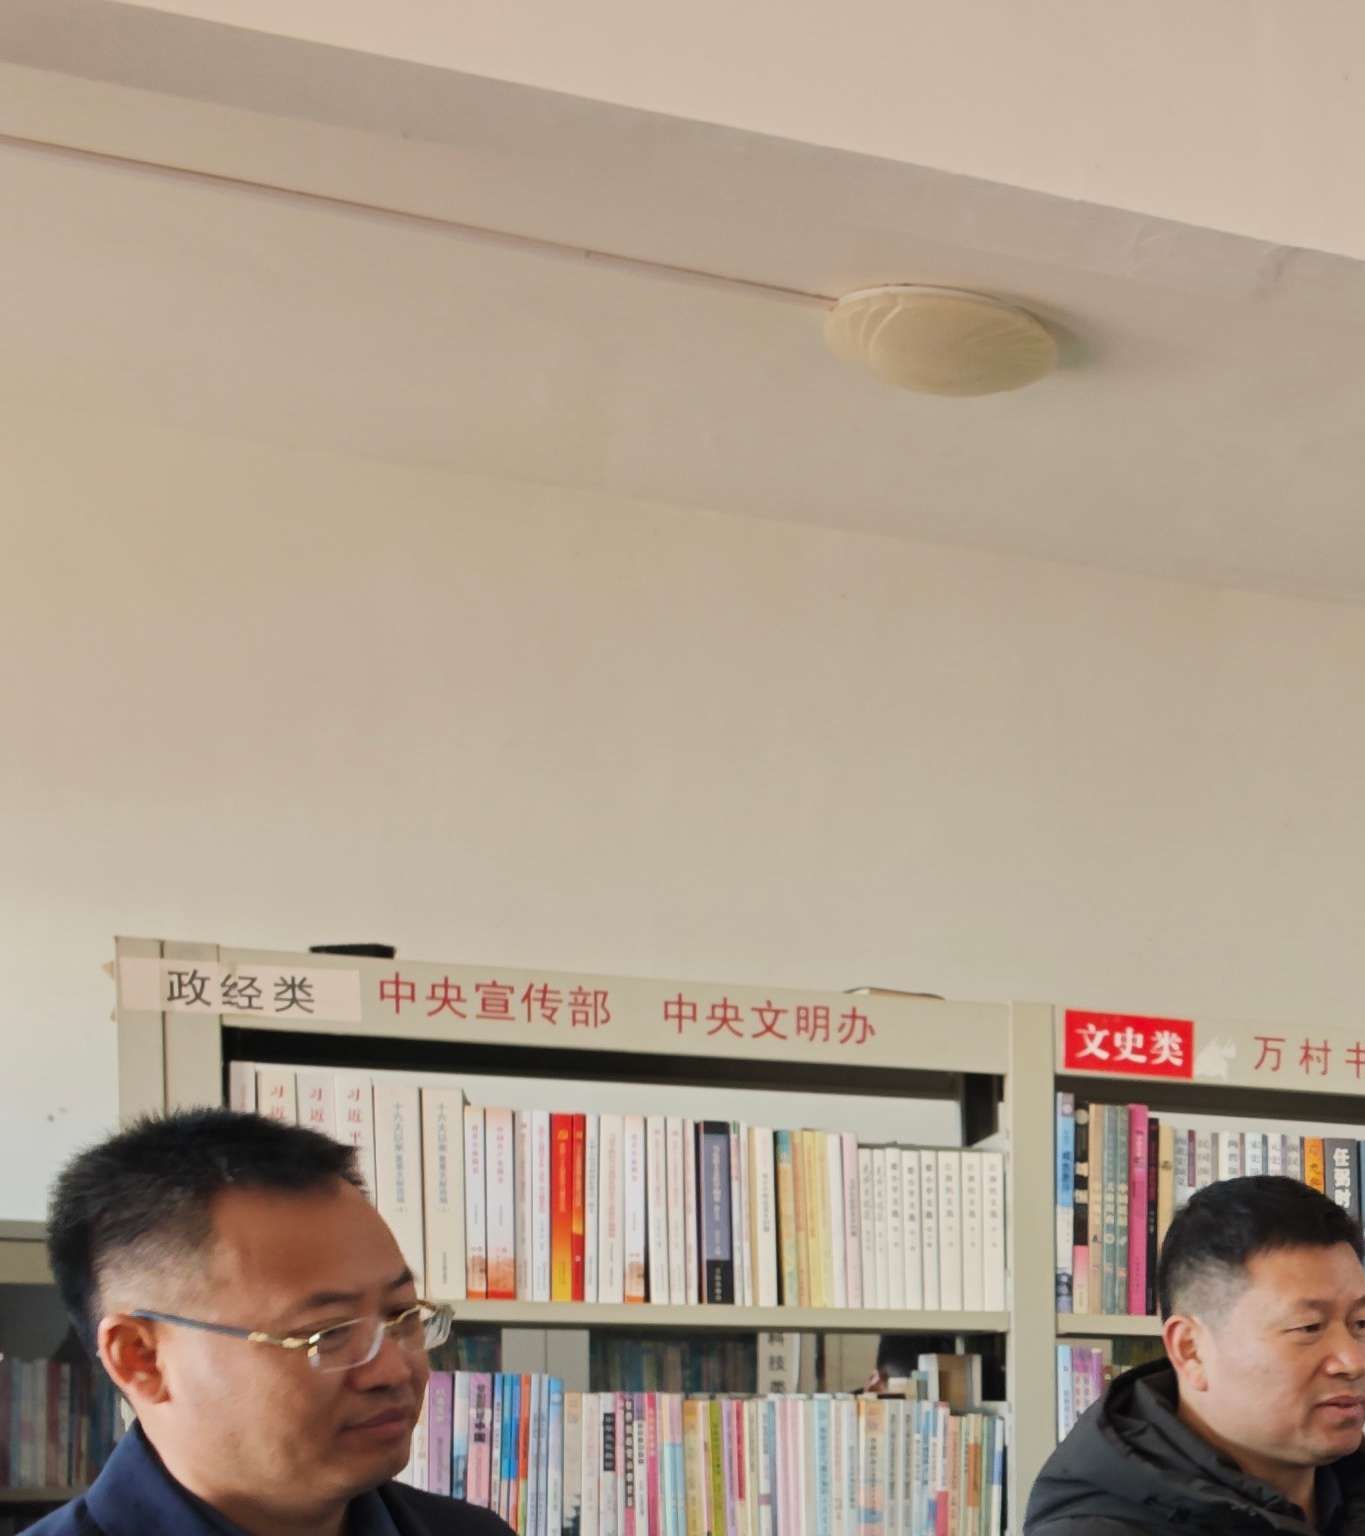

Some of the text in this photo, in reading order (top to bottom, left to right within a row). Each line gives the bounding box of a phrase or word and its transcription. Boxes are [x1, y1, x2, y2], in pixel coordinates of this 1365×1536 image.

[166, 970, 316, 1014] 政经类
[378, 971, 876, 1046] 中央宣传部 中央文明办
[1075, 1022, 1185, 1067] 文史类
